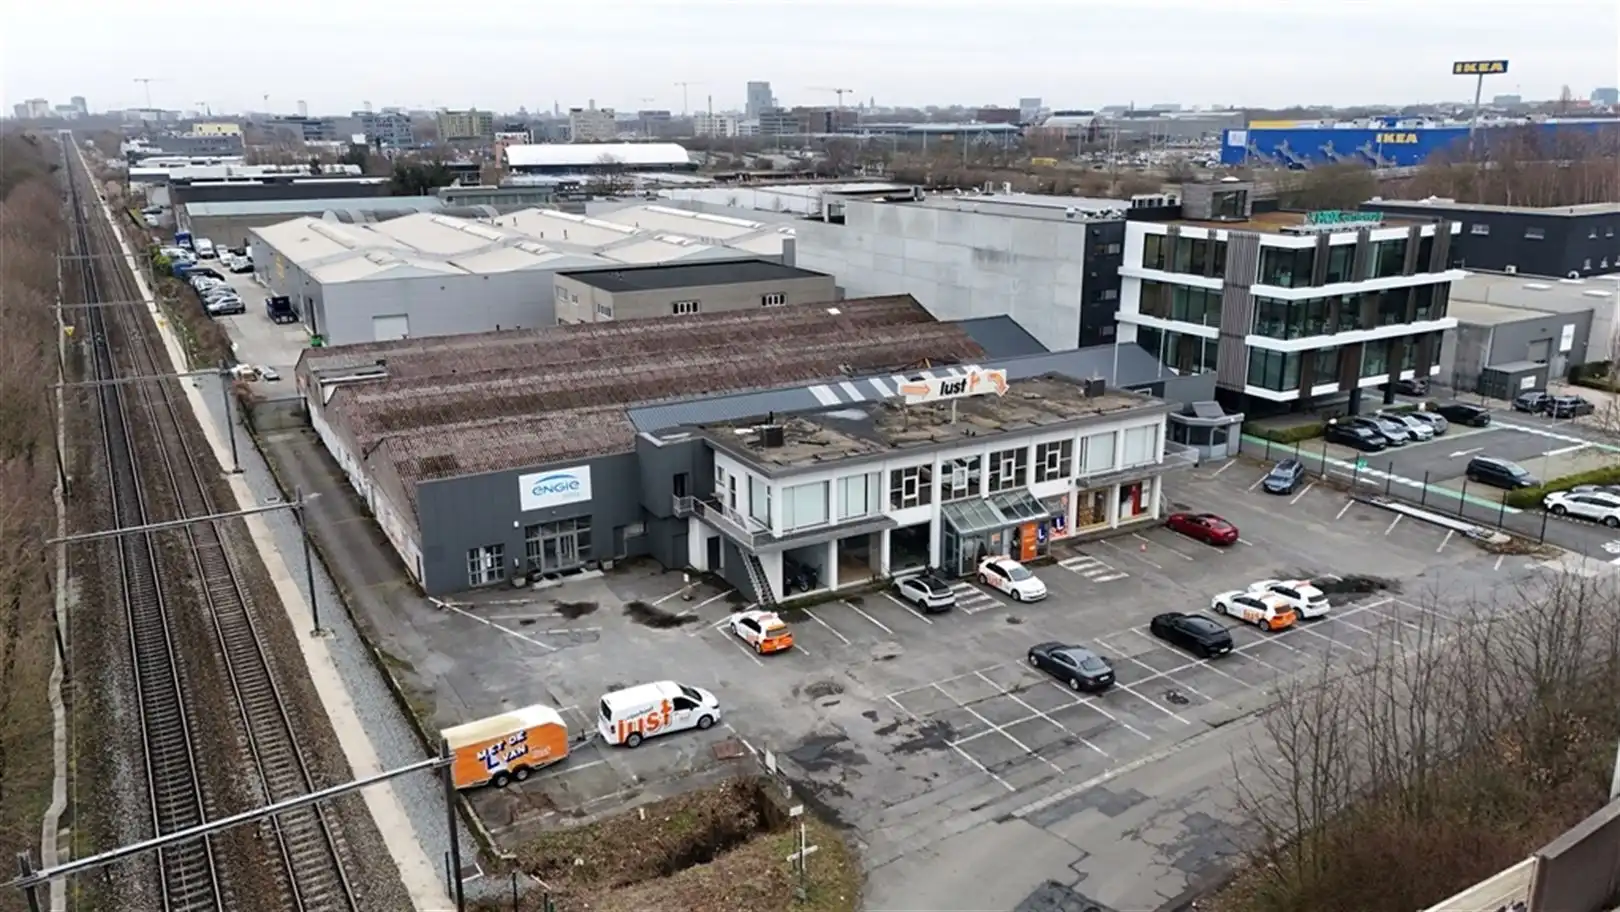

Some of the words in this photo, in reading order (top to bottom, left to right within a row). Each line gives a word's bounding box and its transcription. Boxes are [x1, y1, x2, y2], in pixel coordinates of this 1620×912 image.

[1455, 63, 1504, 72] IKEA
[1376, 133, 1417, 143] IKEA
[940, 378, 966, 395] lust
